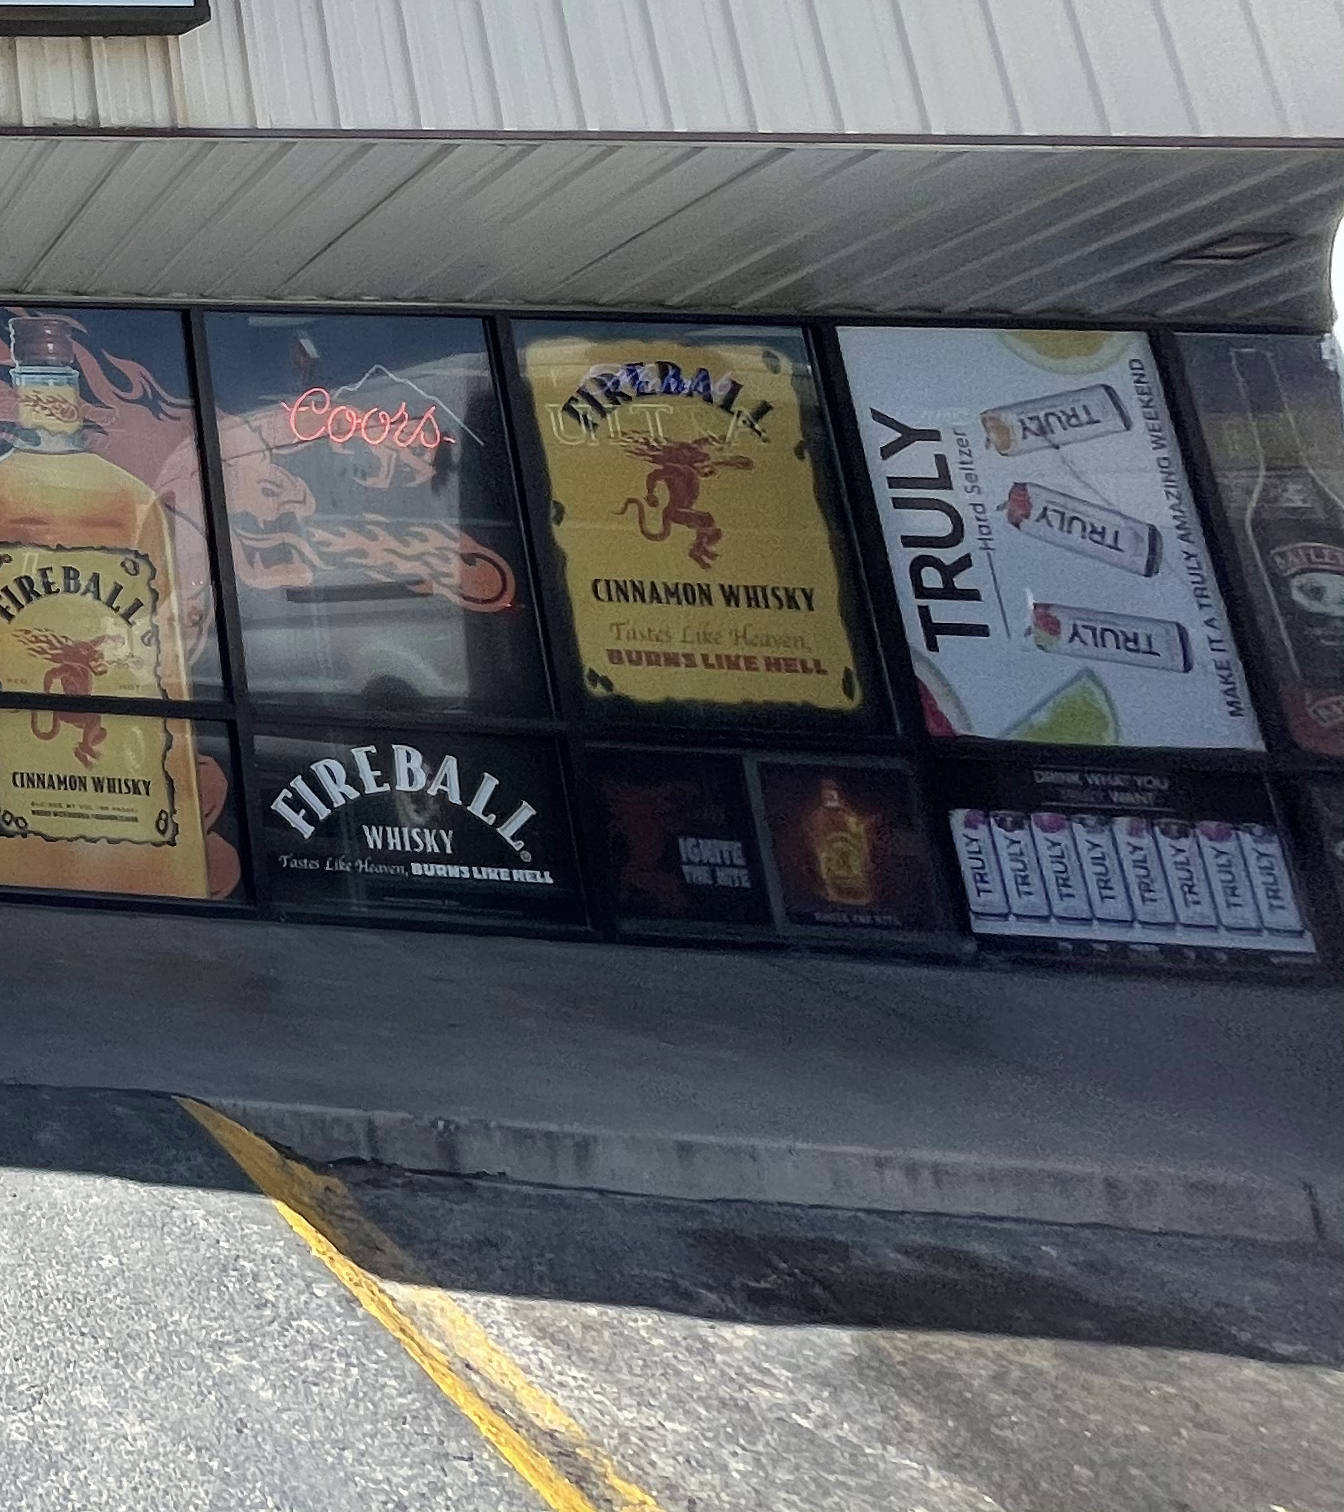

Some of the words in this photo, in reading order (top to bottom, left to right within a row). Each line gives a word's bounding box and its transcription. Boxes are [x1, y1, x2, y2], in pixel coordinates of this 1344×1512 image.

[282, 386, 445, 448] Coors
[1019, 404, 1101, 440] TRULY
[1128, 358, 1168, 451] WEEKEND
[953, 426, 982, 495] Seltzer
[869, 407, 991, 653] TRULY
[969, 501, 996, 552] Hard
[1035, 505, 1125, 552] TRULY
[1157, 455, 1194, 546] AMAZING
[591, 578, 714, 607] CINNAMON
[718, 583, 815, 612] WHISKY
[1182, 549, 1213, 611] TRULY
[610, 622, 672, 643] Tastes
[680, 625, 722, 646] Like
[1068, 622, 1161, 657] TRULY
[1204, 617, 1218, 629] A
[1210, 637, 1229, 654] IT
[606, 649, 698, 668] BURNS
[700, 652, 760, 672] LIKE
[764, 655, 829, 675] HELL
[1212, 658, 1244, 718] MAKE
[11, 771, 88, 792] CINNAMON
[90, 776, 151, 797] WHISKY
[270, 744, 537, 852] FIREBALL
[1133, 775, 1169, 789] YOU
[278, 854, 320, 869] Tastes
[325, 855, 352, 872] Like
[411, 862, 470, 879] BURNS
[472, 866, 510, 881] LIKE
[512, 869, 554, 884] HELL
[362, 824, 454, 854] WHISKY
[962, 833, 992, 897] TRULY
[1004, 835, 1034, 899] TRULY
[1044, 836, 1076, 901] TRULY
[1085, 839, 1117, 903] TRULY
[1127, 841, 1157, 905] TRULY
[1169, 843, 1201, 908] TRULY
[1210, 845, 1243, 909] TRULY
[1252, 847, 1286, 912] TRULY
